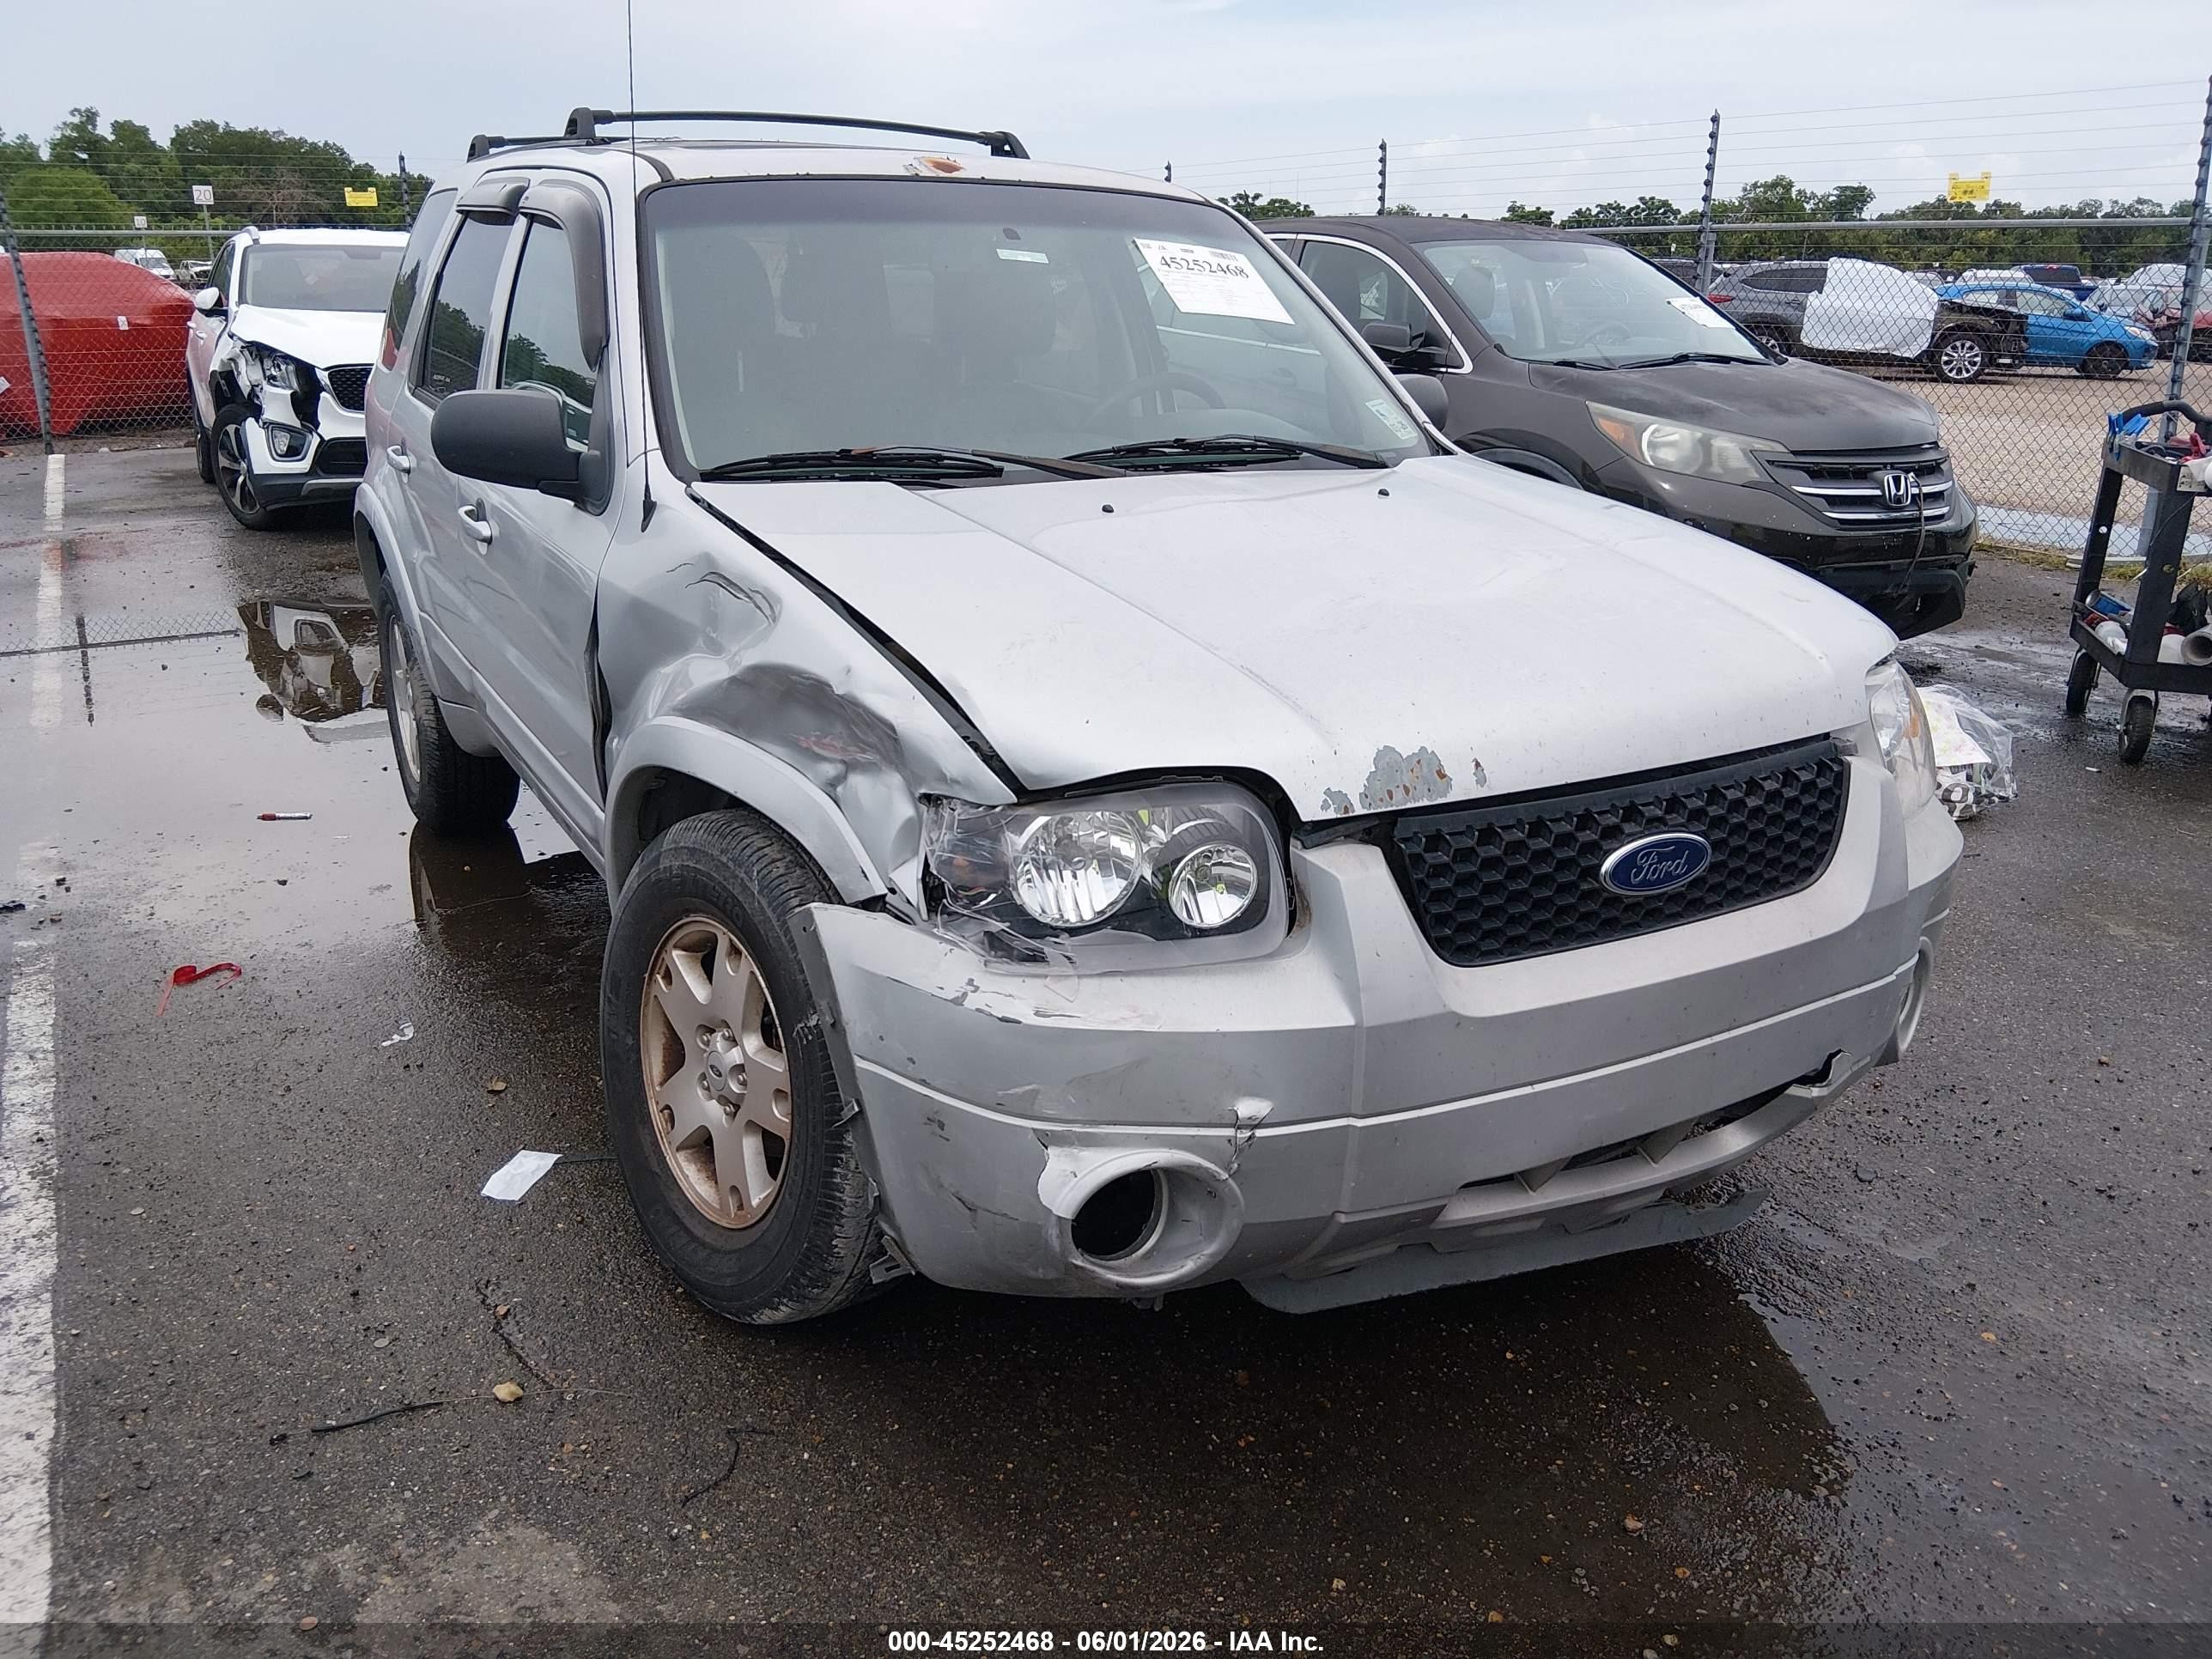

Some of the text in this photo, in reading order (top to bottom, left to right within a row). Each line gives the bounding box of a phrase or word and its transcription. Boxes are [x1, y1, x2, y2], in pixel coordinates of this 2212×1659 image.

[194, 189, 212, 201] 20
[1159, 255, 1249, 279] 45252468
[1631, 845, 1689, 884] Ford
